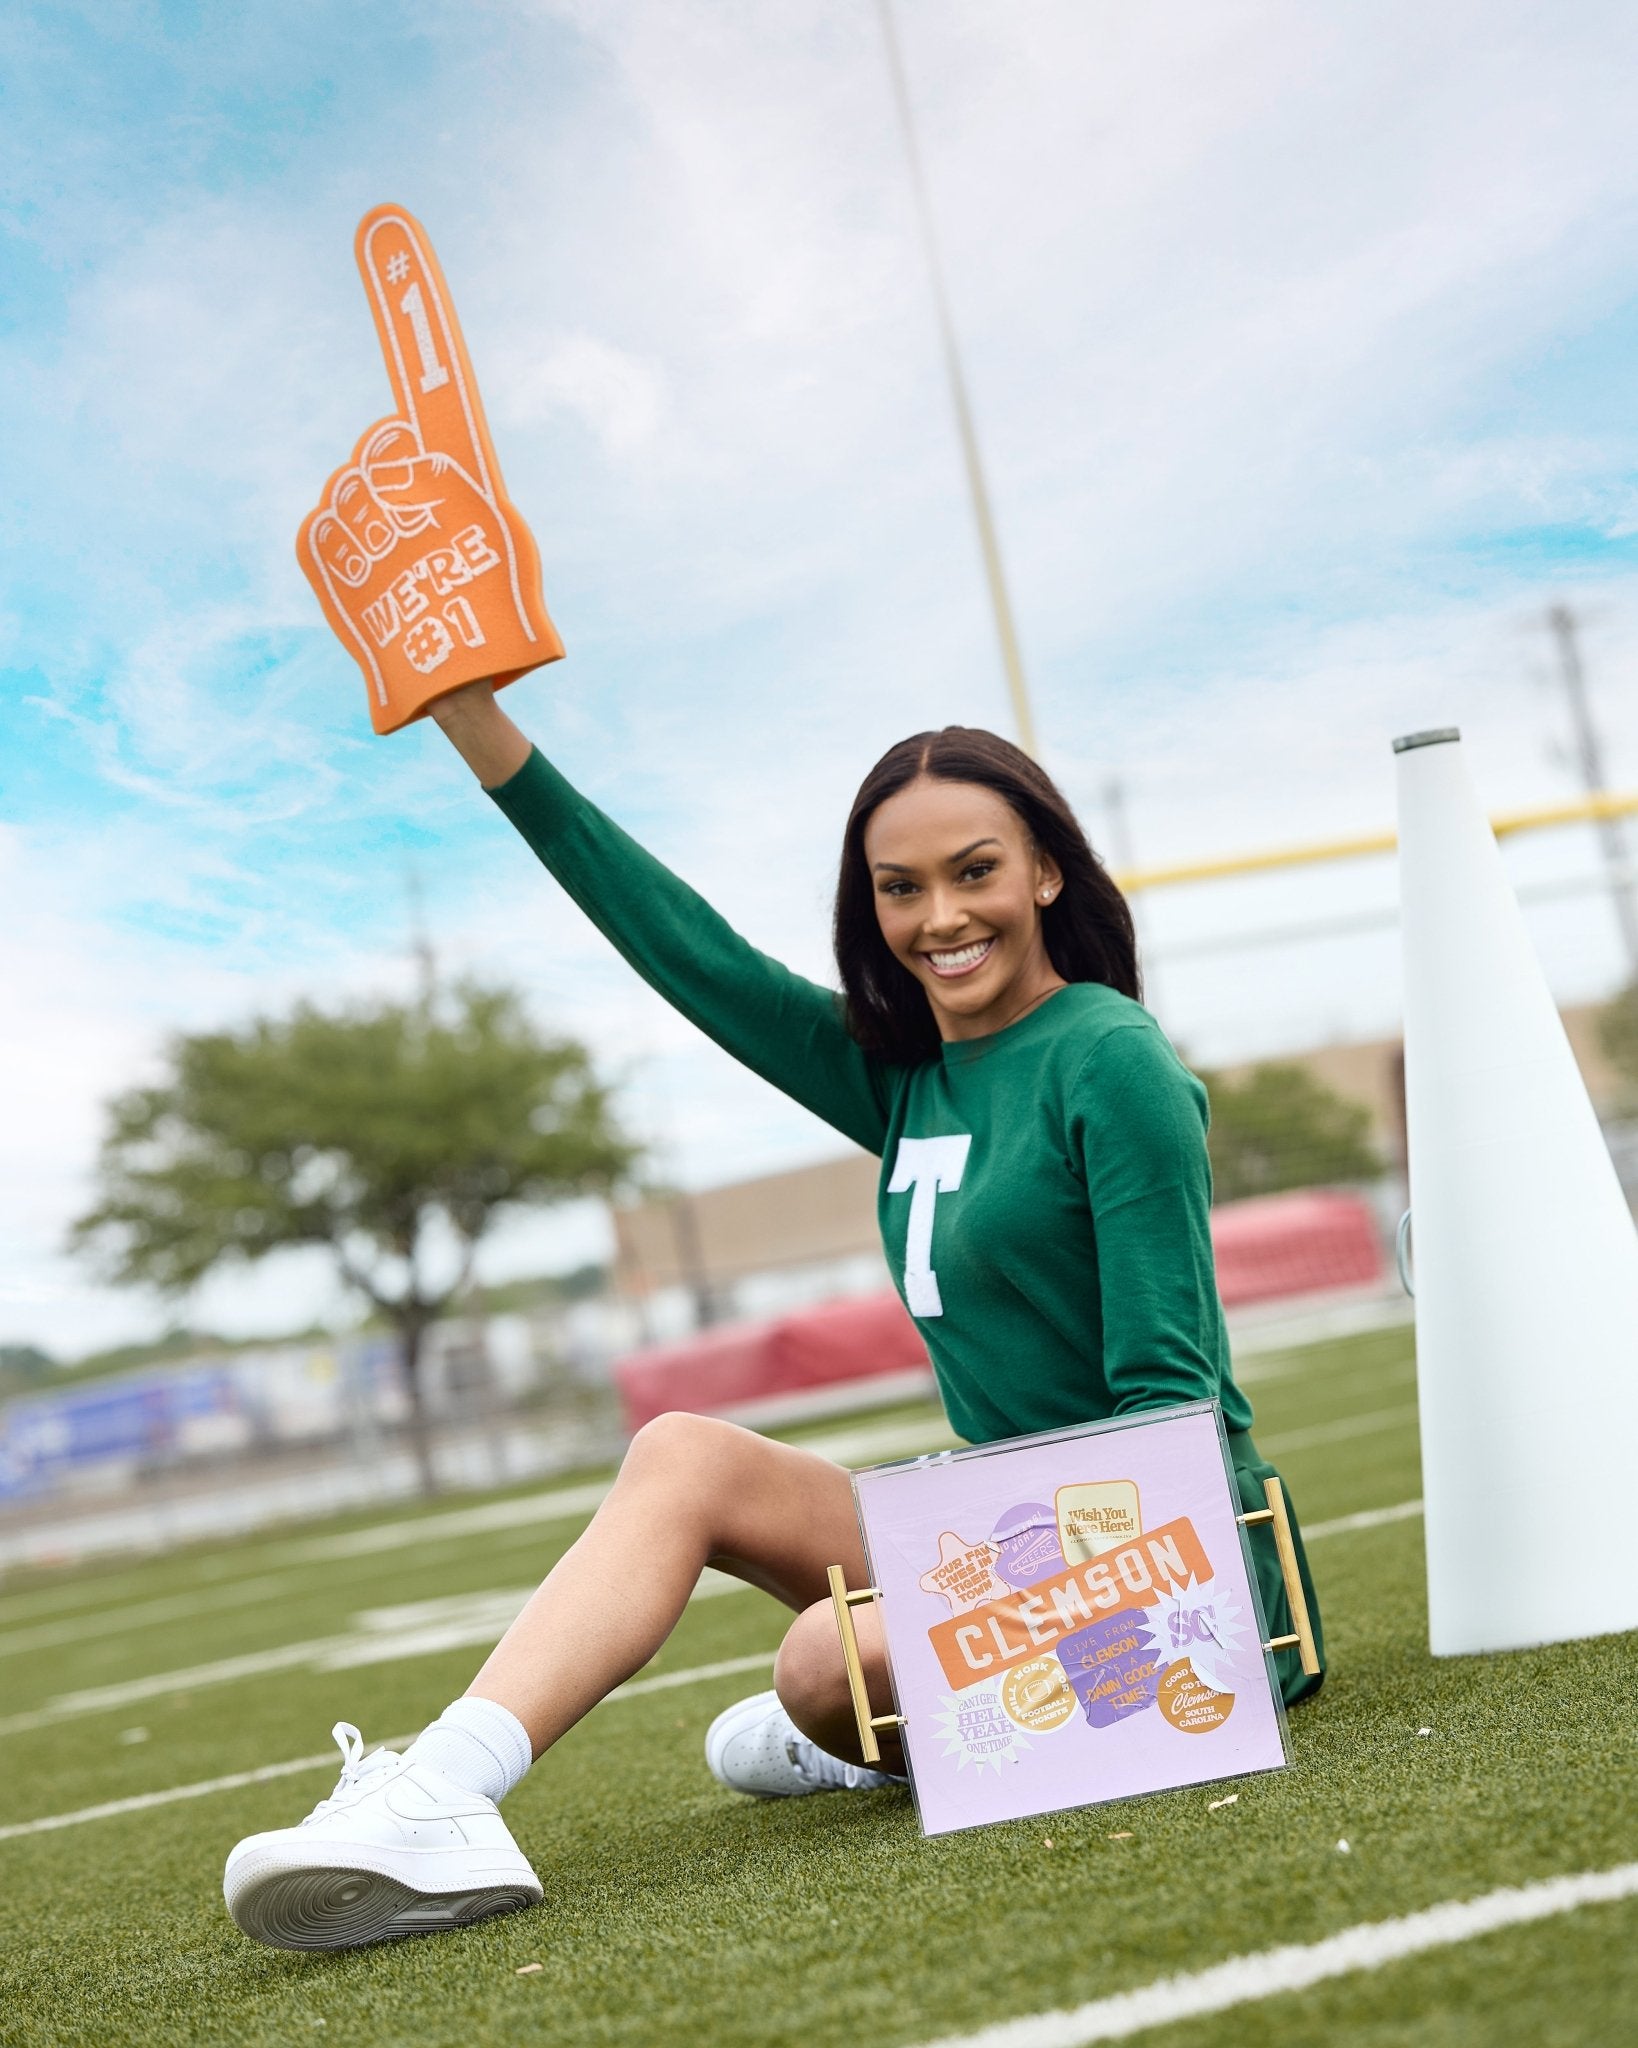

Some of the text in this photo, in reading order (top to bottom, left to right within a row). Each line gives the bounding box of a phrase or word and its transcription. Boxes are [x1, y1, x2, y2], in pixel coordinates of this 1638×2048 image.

[361, 524, 501, 648] WE'RE
[402, 596, 487, 675] #1
[887, 1134, 972, 1317] T
[1068, 1507, 1127, 1522] Wish You
[1065, 1518, 1134, 1537] Were Here!
[1011, 1530, 1035, 1553] MORE
[1016, 1540, 1056, 1569] CHEERS
[931, 1558, 963, 1583] YOUR
[939, 1555, 993, 1590] LIVES IN
[951, 1569, 990, 1594] TIGER
[954, 1534, 1189, 1671] CLEMSON
[958, 1579, 993, 1603] TOWN
[1066, 1619, 1136, 1657] LIVE FROM
[1081, 1634, 1139, 1669] CLEMSON
[1013, 1662, 1049, 1681] WORK
[1051, 1667, 1069, 1693] FOR
[1086, 1676, 1122, 1703] DAMN
[1165, 1668, 1189, 1688] GOOD
[1180, 1681, 1195, 1691] GO
[979, 1693, 998, 1705] GET
[1021, 1697, 1070, 1720] FOOTBALL
[1028, 1706, 1069, 1726] TICKETS
[1179, 1712, 1224, 1727] CAROLINA
[1184, 1705, 1215, 1718] SOUTH
[957, 1719, 1017, 1742] YEAH
[966, 1735, 1013, 1754] ONE TIME
